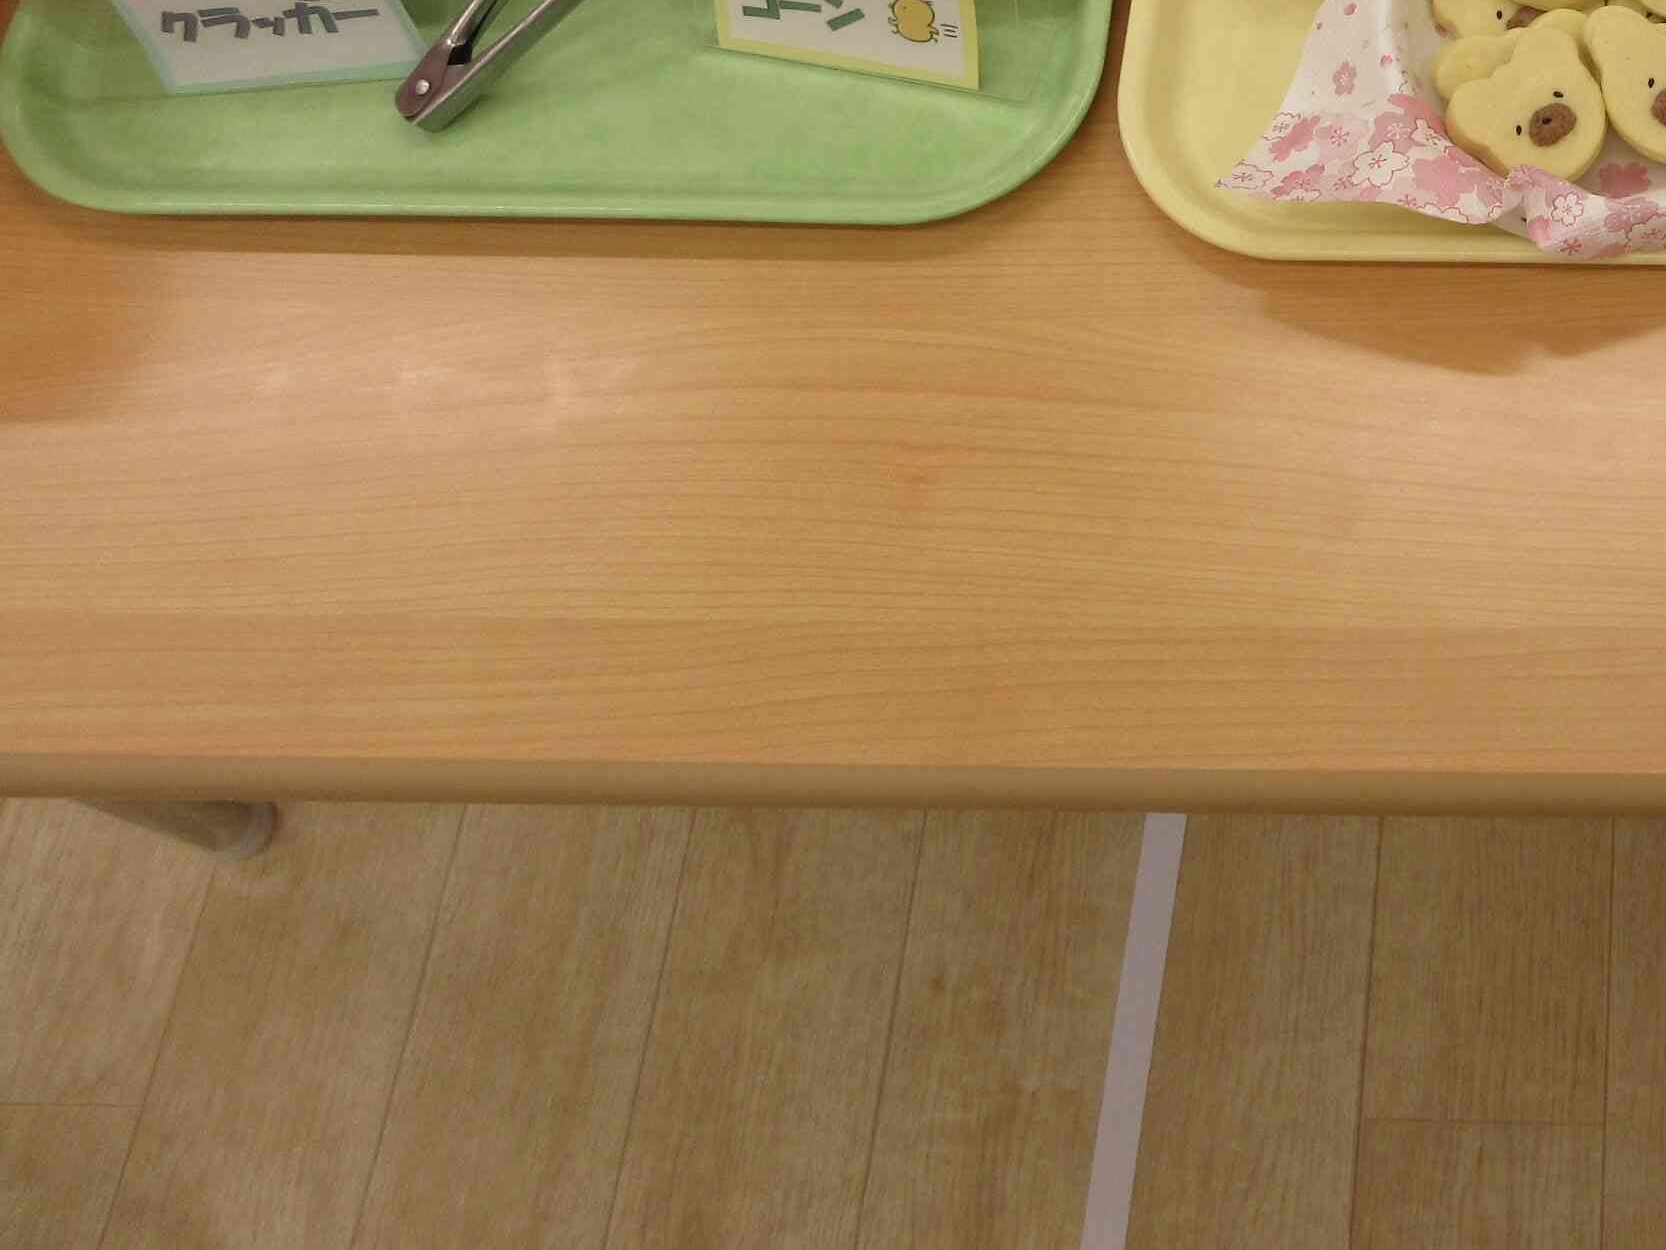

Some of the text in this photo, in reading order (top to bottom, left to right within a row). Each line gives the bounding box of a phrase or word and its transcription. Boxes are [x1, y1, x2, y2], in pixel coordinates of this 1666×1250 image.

[160, 1, 380, 43] クラッカー
